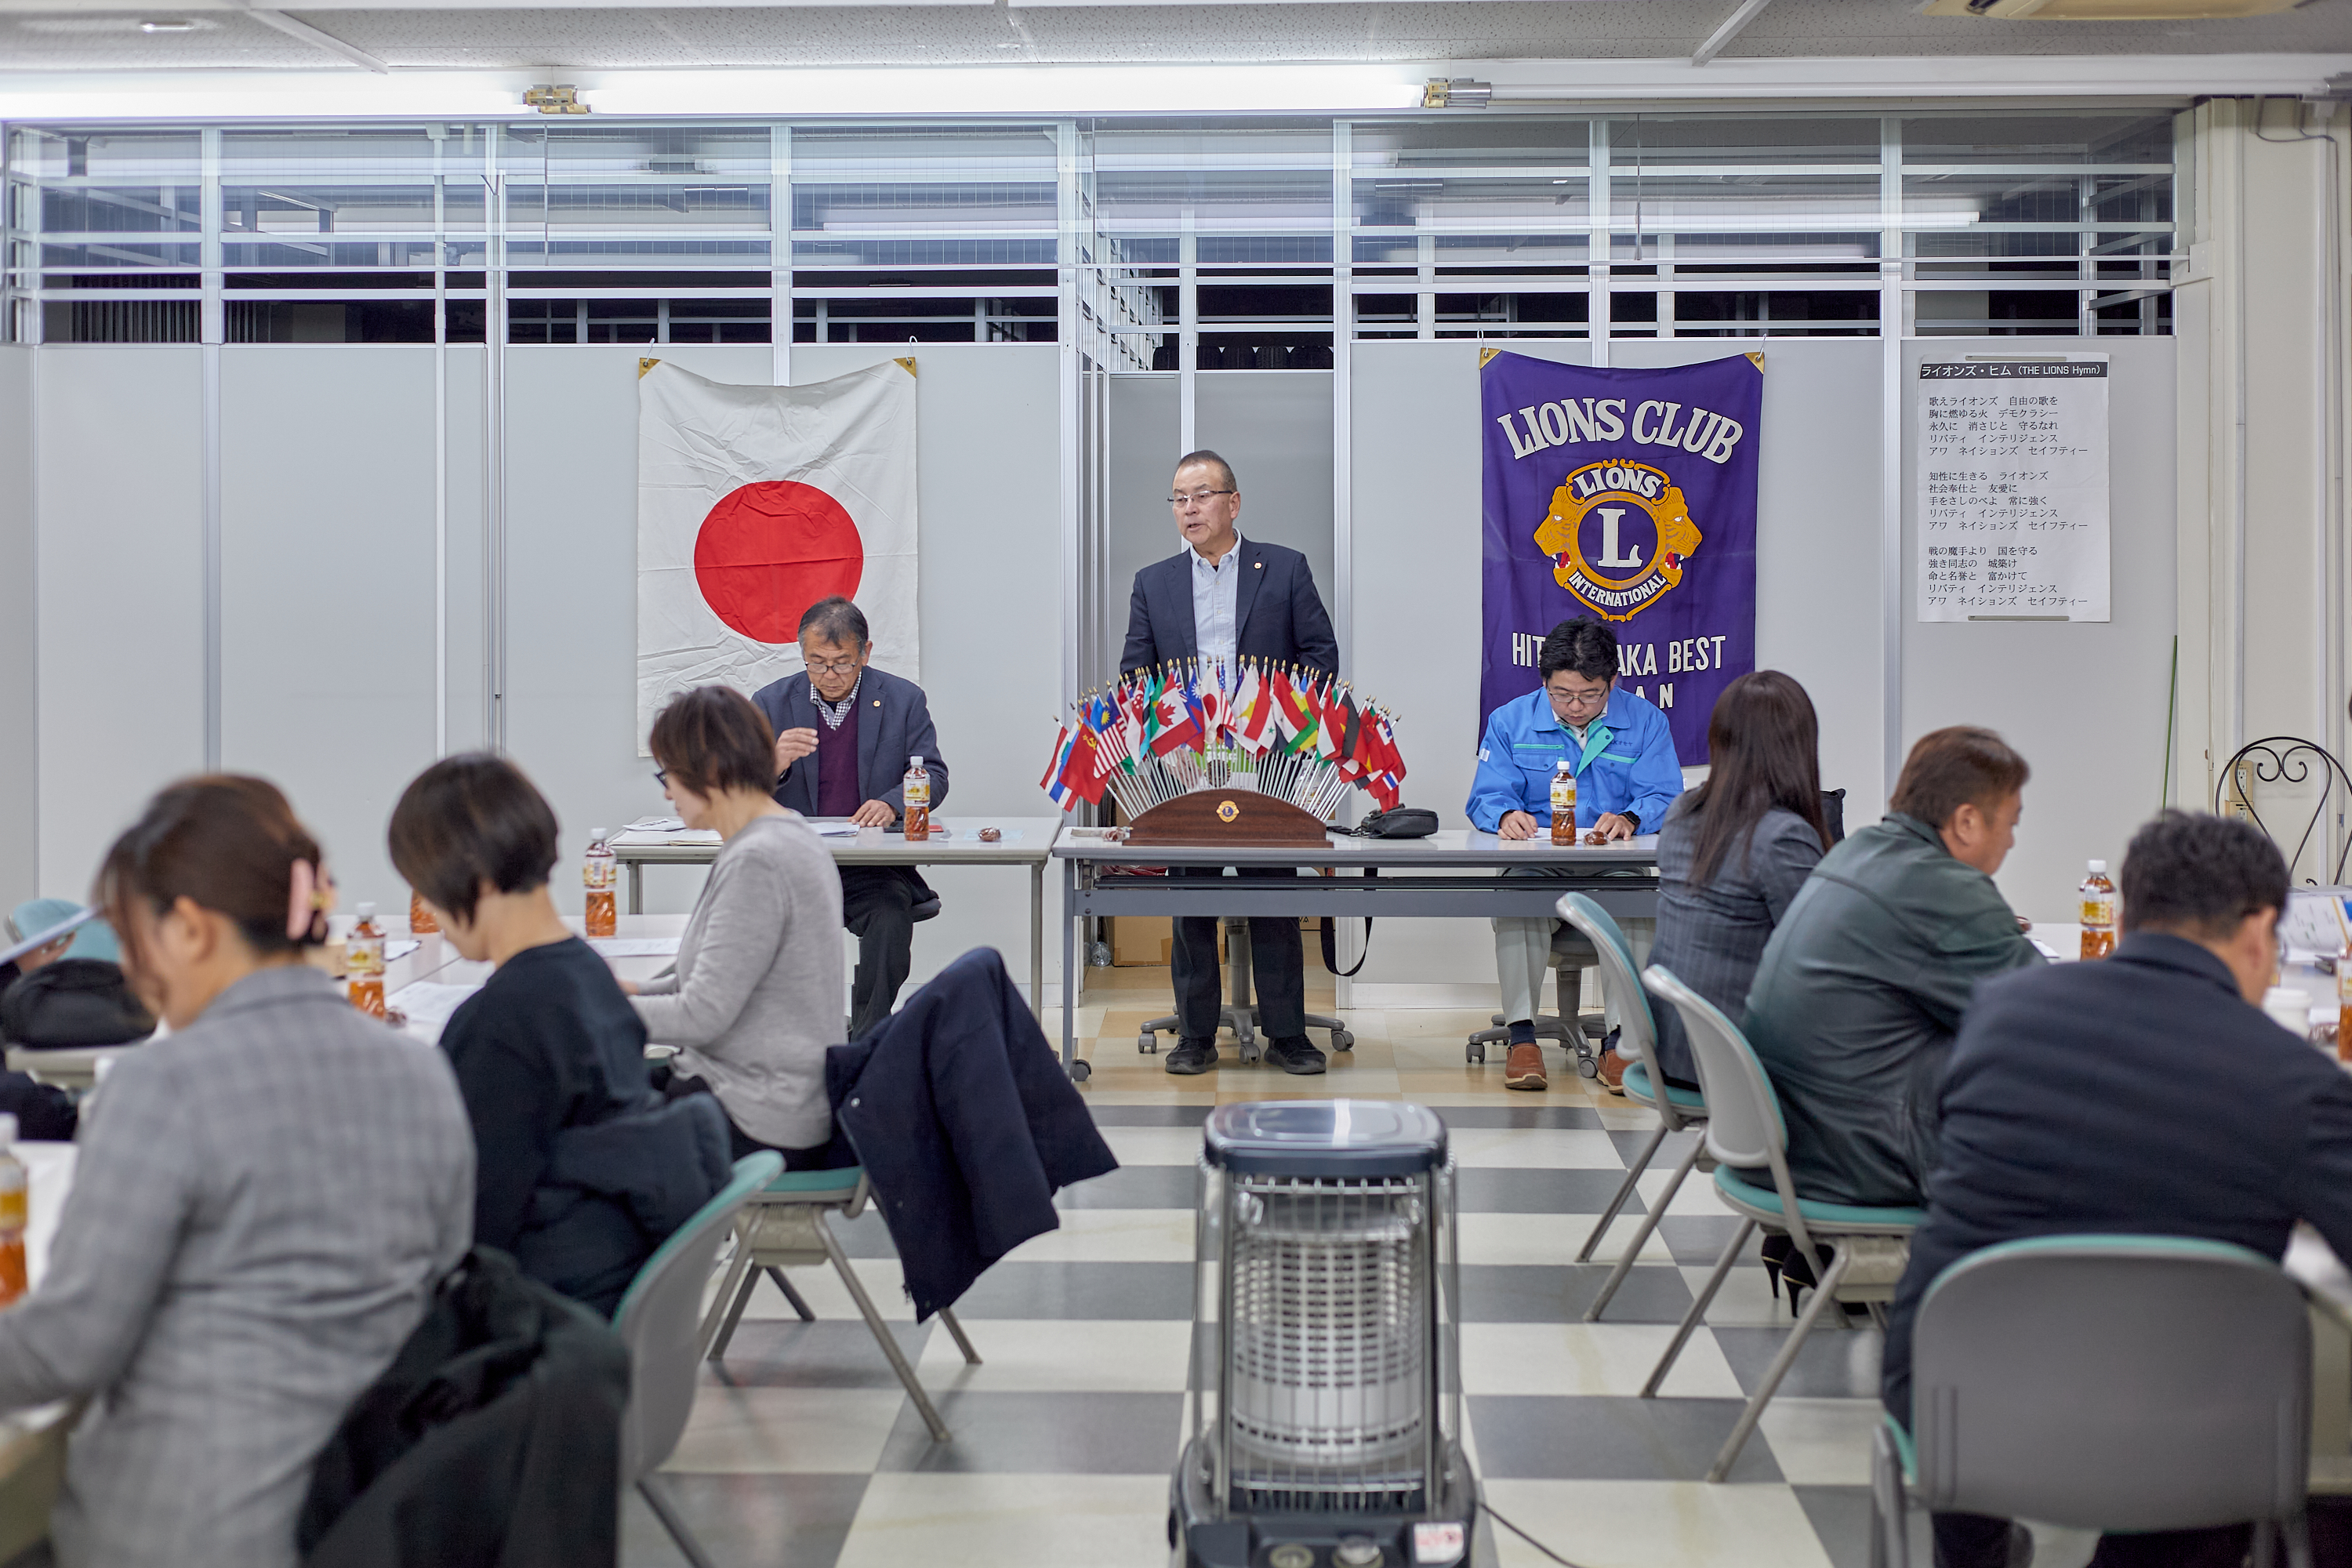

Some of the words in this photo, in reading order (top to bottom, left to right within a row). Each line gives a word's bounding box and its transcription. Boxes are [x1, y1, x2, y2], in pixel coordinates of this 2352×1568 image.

[1921, 365, 2013, 377] ライオンズ・ヒム
[2043, 365, 2071, 376] LIONS
[1929, 396, 1998, 407] 歌えライオンズ
[2009, 395, 2058, 406] 自由の歌を
[1929, 408, 1988, 419] 胸に燃ゆる火
[1998, 408, 2059, 419] デモクラシー
[1497, 397, 1625, 459] LIONS
[1631, 399, 1744, 464] CLUB
[1929, 421, 1958, 432] 永久に
[1968, 421, 2008, 431] 消さじと
[2018, 420, 2059, 431] 守るなれ
[1930, 434, 1966, 444] リバティ
[1978, 434, 2058, 444] インテリジェンス
[1929, 446, 1948, 456] アワ
[1958, 445, 2019, 456] ネイションズ
[2028, 446, 2089, 456] セイフティー
[1928, 471, 1987, 481] 知性に生きる
[1999, 470, 2049, 481] ライオンズ
[1573, 466, 1662, 497] LIONS
[1928, 483, 1977, 494] 社会奉仕と
[1987, 483, 2018, 494] 友愛に
[1929, 495, 1998, 506] 手をさしのべよ
[2008, 495, 2047, 506] 常に強く
[1929, 508, 1966, 518] リバティ
[1978, 508, 2058, 518] インテリジェンス
[1929, 521, 1947, 531] アワ
[1958, 520, 2019, 531] ネイションズ
[2028, 521, 2089, 531] セイフティー
[1597, 508, 1642, 568] L
[1928, 546, 1987, 557] 戦の魔手より
[1998, 546, 2038, 556] 国を守る
[1928, 558, 1978, 569] 強き同志の
[1987, 558, 2018, 569] 城築け
[1928, 571, 1976, 582] 命と名誉と
[1987, 571, 2027, 582] 富かけて
[1568, 571, 1667, 607] INTERNATIONAL
[1929, 583, 1965, 593] リバティ
[1977, 583, 2057, 593] インテリジェンス
[1928, 596, 1947, 606] アワ
[1957, 596, 2018, 606] ネイションズ
[2027, 597, 2088, 606] セイフティー
[1512, 632, 1657, 677] HITAKA
[1668, 635, 1726, 673] BEST
